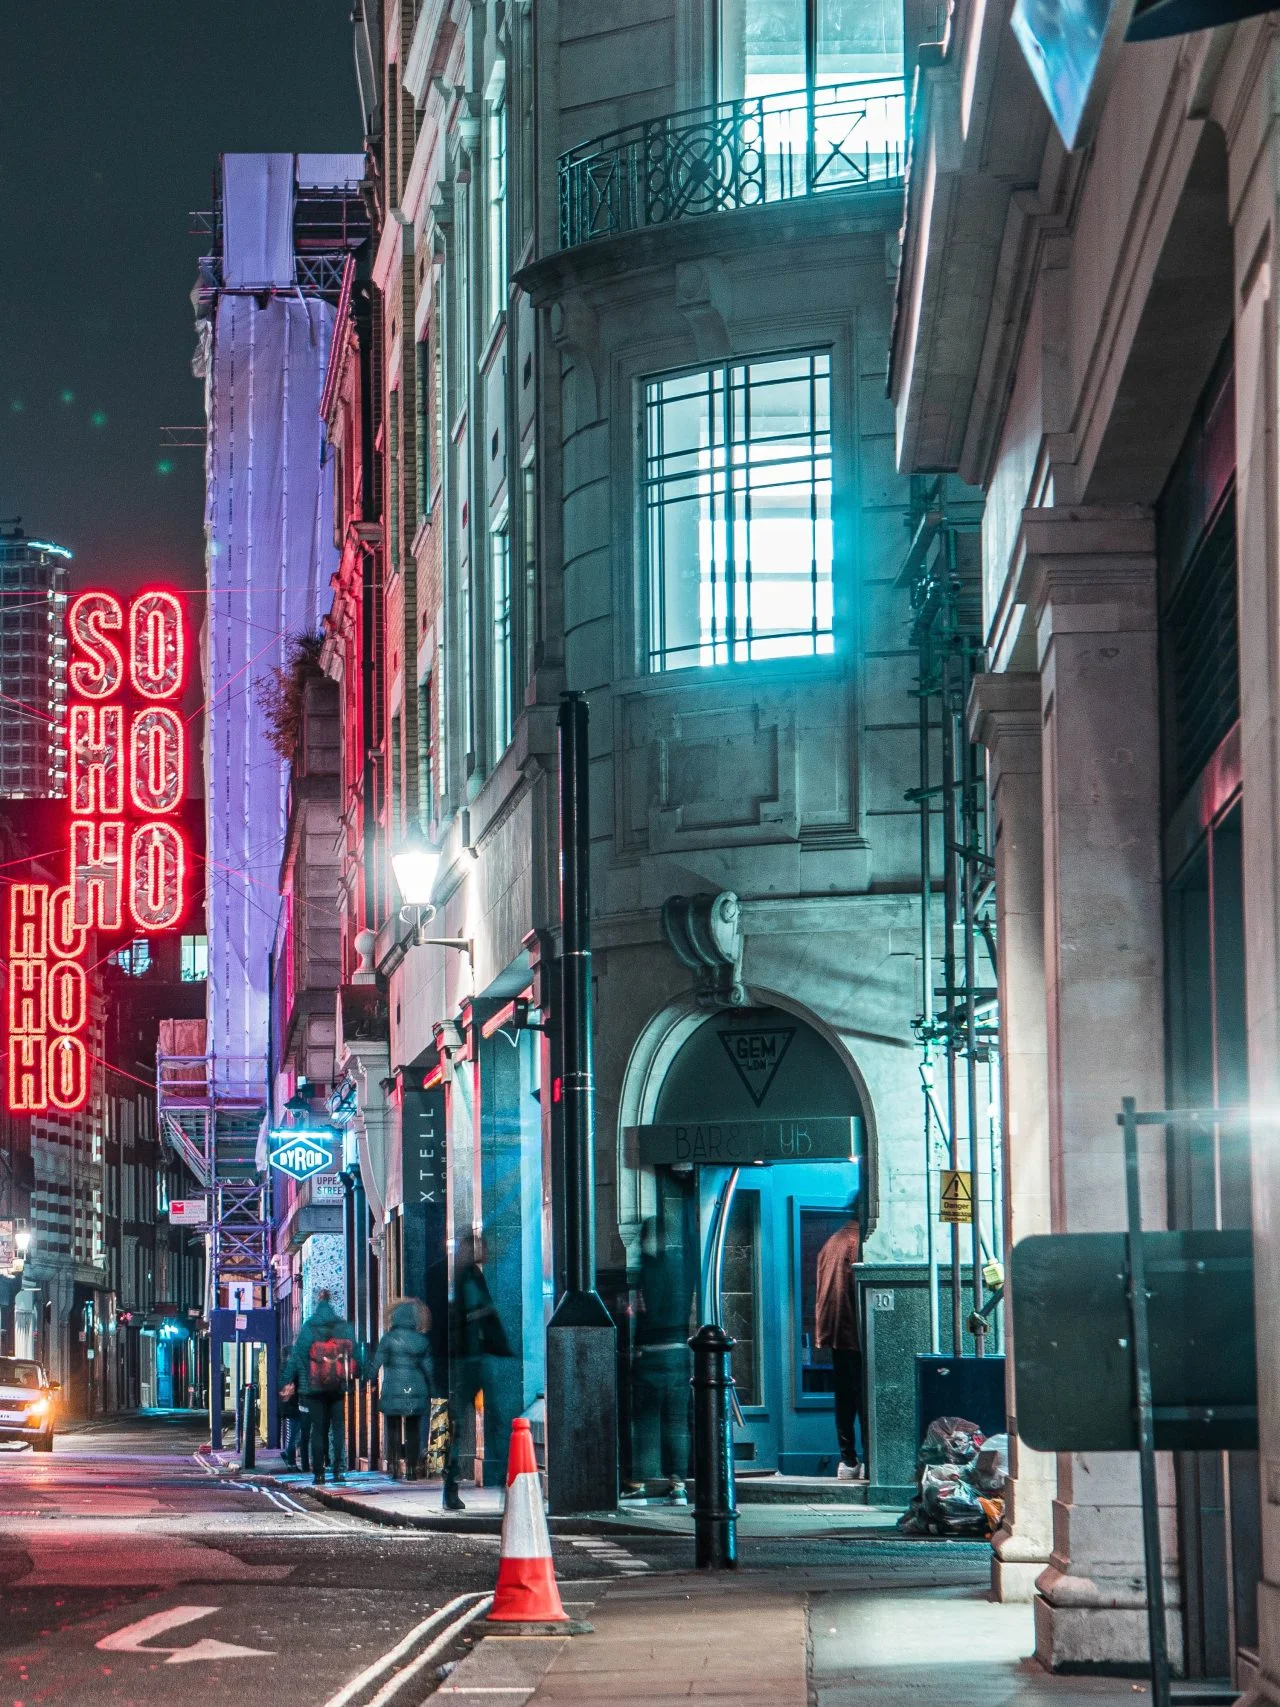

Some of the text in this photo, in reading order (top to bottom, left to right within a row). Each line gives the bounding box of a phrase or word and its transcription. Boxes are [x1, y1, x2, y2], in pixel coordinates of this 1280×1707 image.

[69, 591, 184, 700] SO
[70, 705, 184, 815] HO
[70, 820, 184, 930] HO
[10, 883, 86, 959] HO
[9, 958, 87, 1034] HO
[9, 1034, 87, 1110] HO
[736, 1036, 777, 1059] GEM
[279, 1147, 323, 1171] BYRON
[316, 1176, 340, 1185] UPPE
[943, 1201, 969, 1210] Danger
[875, 1293, 891, 1308] 10
